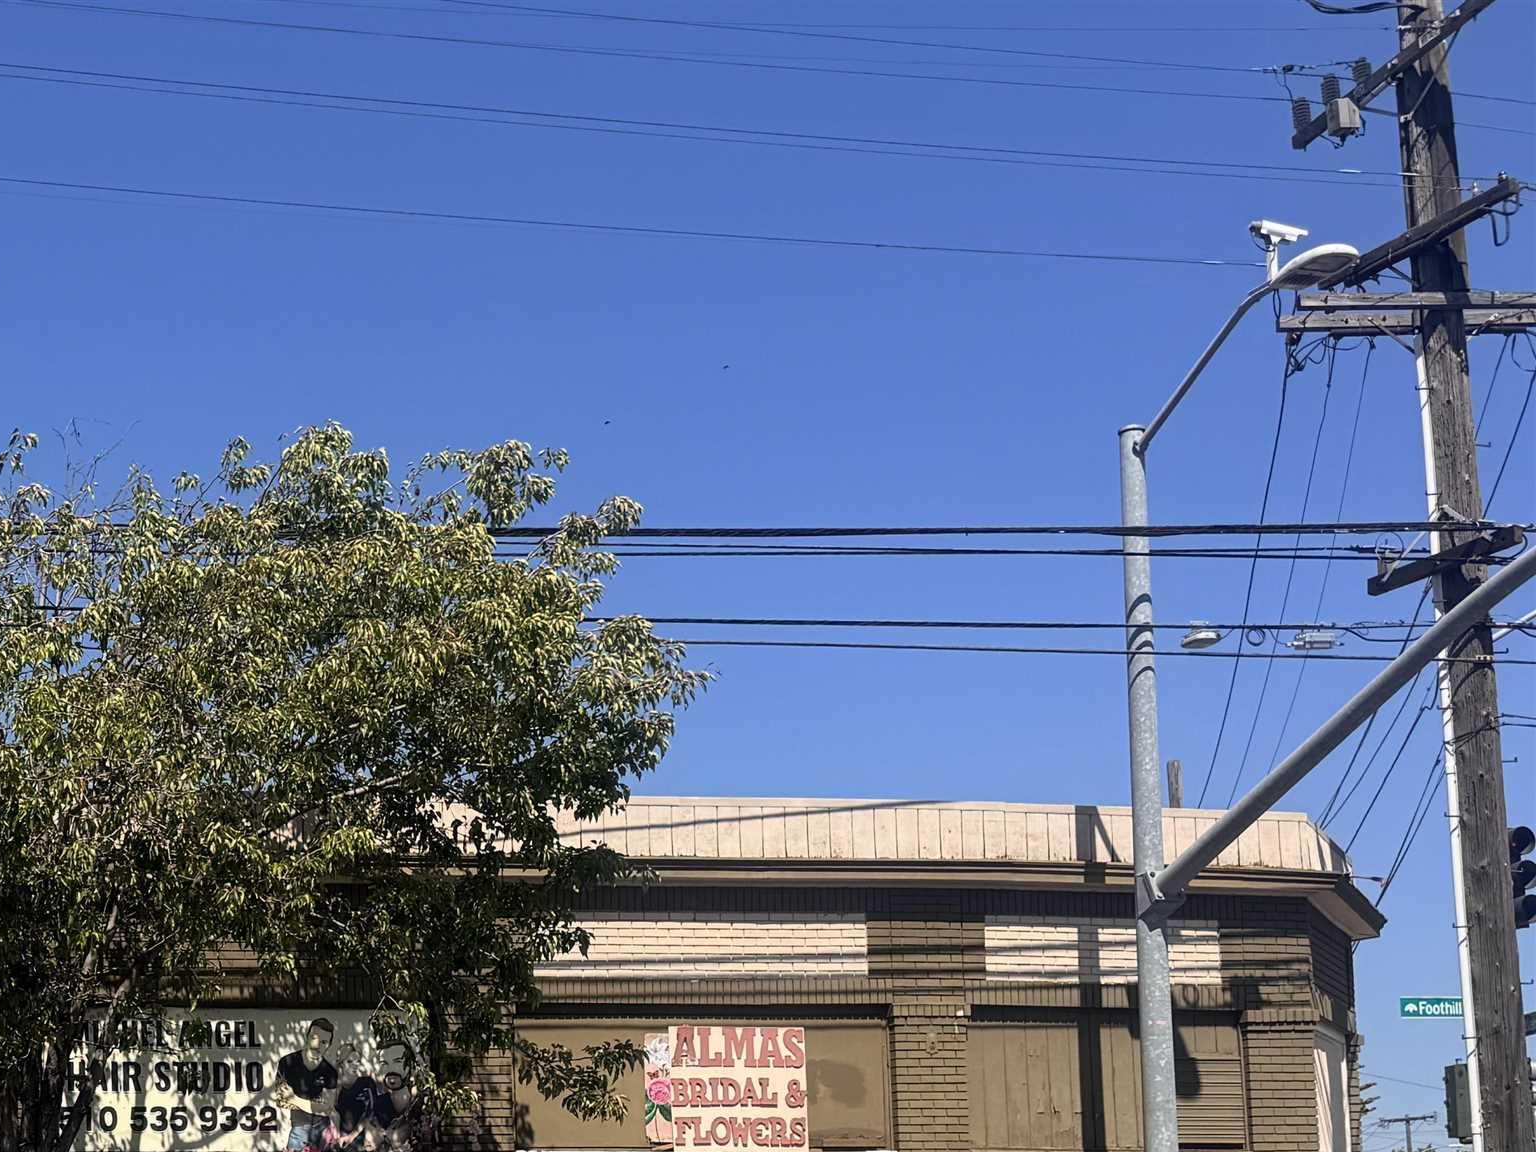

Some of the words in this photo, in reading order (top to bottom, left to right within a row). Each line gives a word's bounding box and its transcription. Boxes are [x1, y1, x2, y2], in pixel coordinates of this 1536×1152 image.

[1418, 1001, 1463, 1016] Foothill
[671, 1025, 804, 1069] ALMAS
[67, 1061, 142, 1092] HAIR
[154, 1061, 264, 1093] STUDIO
[670, 1077, 778, 1108] BRIDAL
[785, 1079, 808, 1108] &
[130, 1105, 188, 1132] 535
[198, 1105, 279, 1132] 9332
[674, 1116, 807, 1148] FLOWERS
